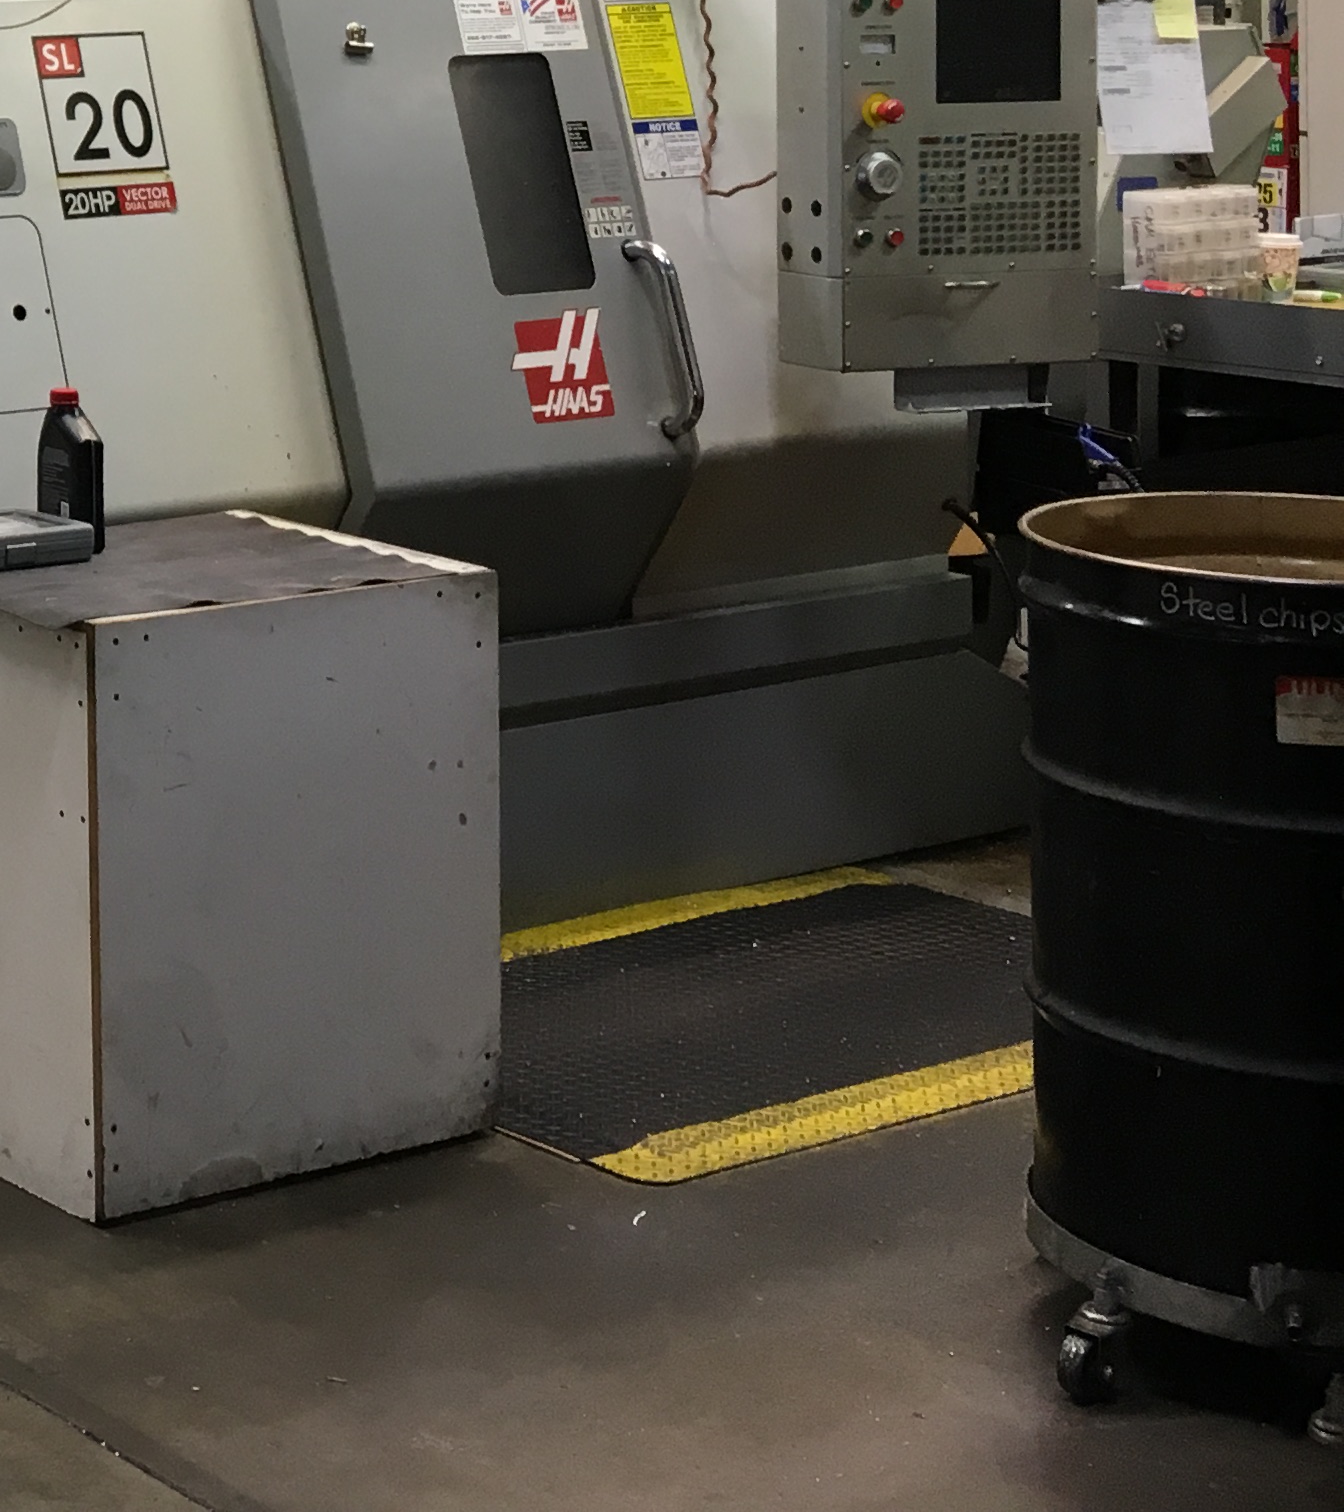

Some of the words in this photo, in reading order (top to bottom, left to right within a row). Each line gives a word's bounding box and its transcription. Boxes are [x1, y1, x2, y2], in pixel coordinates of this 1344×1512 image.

[42, 43, 75, 72] SL
[65, 89, 153, 161] 20
[648, 122, 682, 132] NOTICE
[64, 190, 116, 216] 20HP
[122, 187, 170, 202] VECTOR
[125, 200, 147, 211] DUAL
[148, 199, 172, 210] DRIVE
[531, 384, 611, 418] HAAS
[1161, 582, 1248, 625] Steel
[1259, 597, 1344, 637] chips
